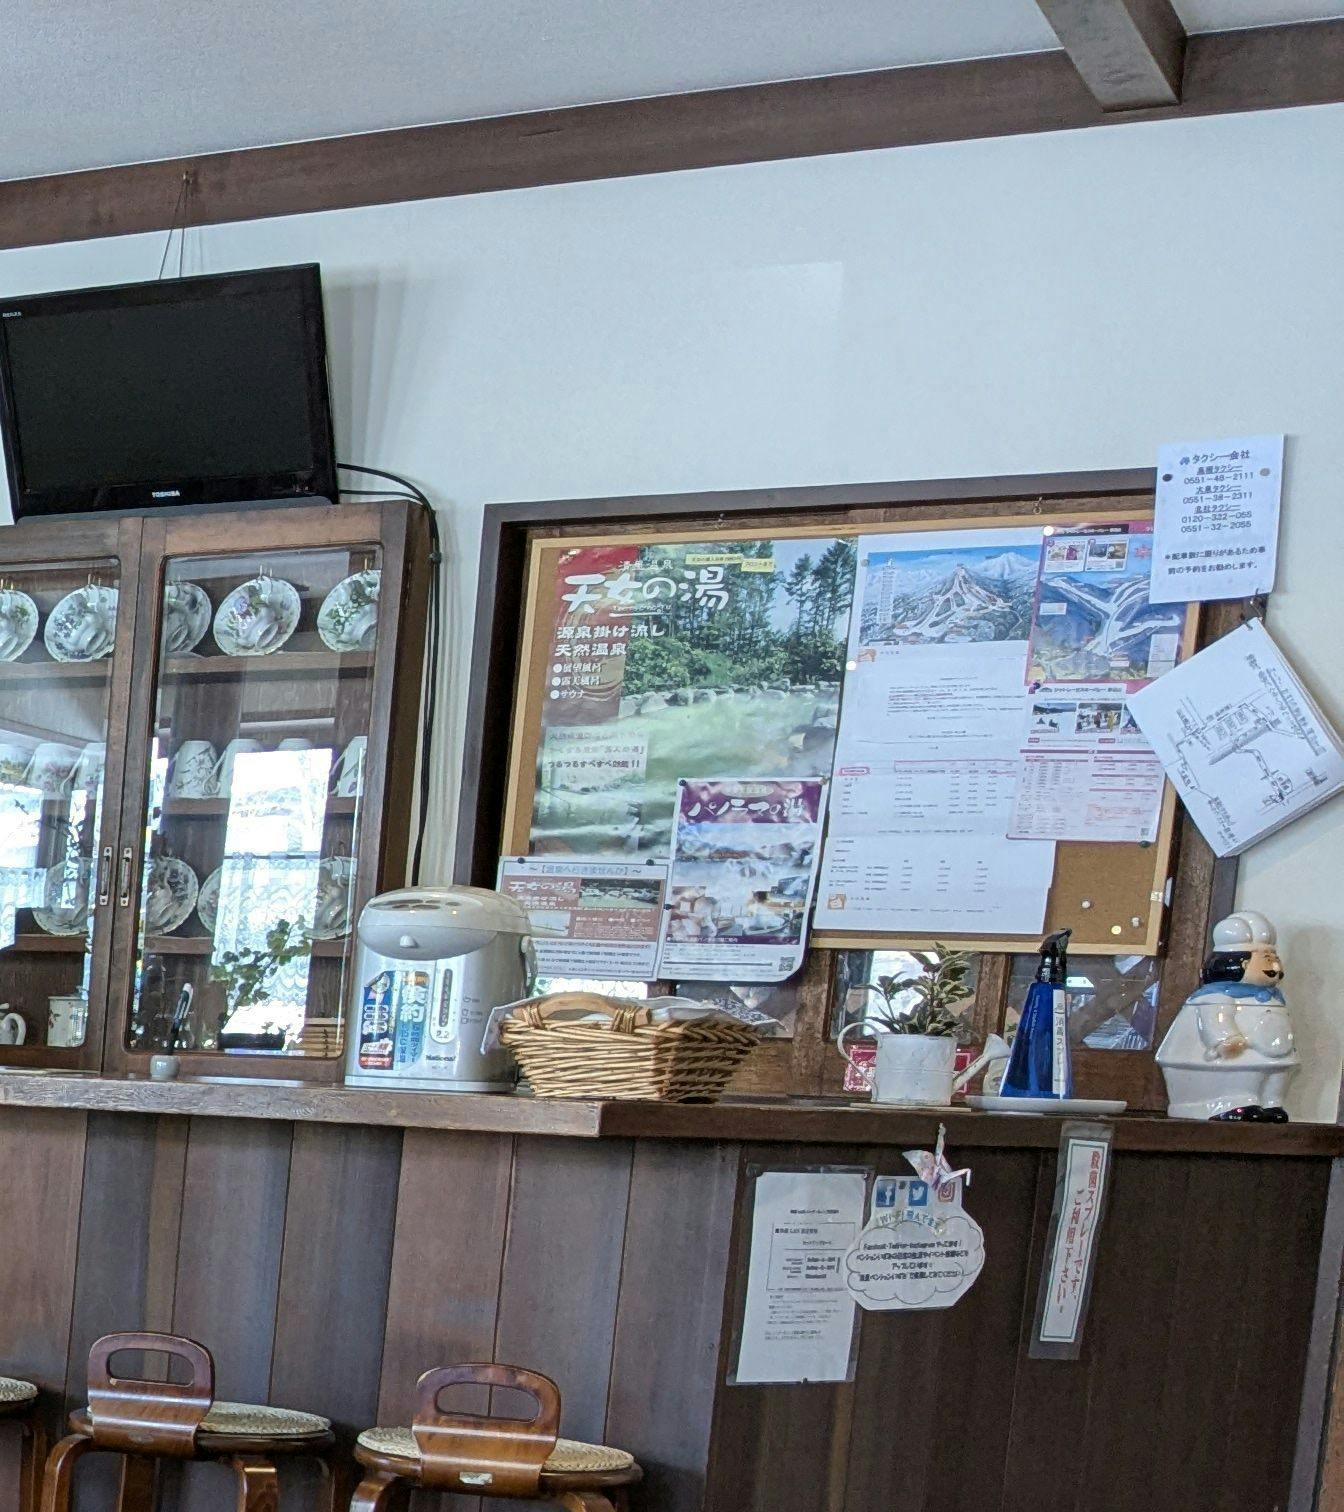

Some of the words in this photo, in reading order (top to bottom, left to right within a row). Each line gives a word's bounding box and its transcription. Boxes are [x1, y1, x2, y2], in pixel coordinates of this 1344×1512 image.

[1192, 450, 1250, 464] タクシー会社
[561, 566, 730, 614] 天女の湯
[556, 624, 665, 641] 源泉掛け流し
[554, 642, 627, 658] 天然温泉
